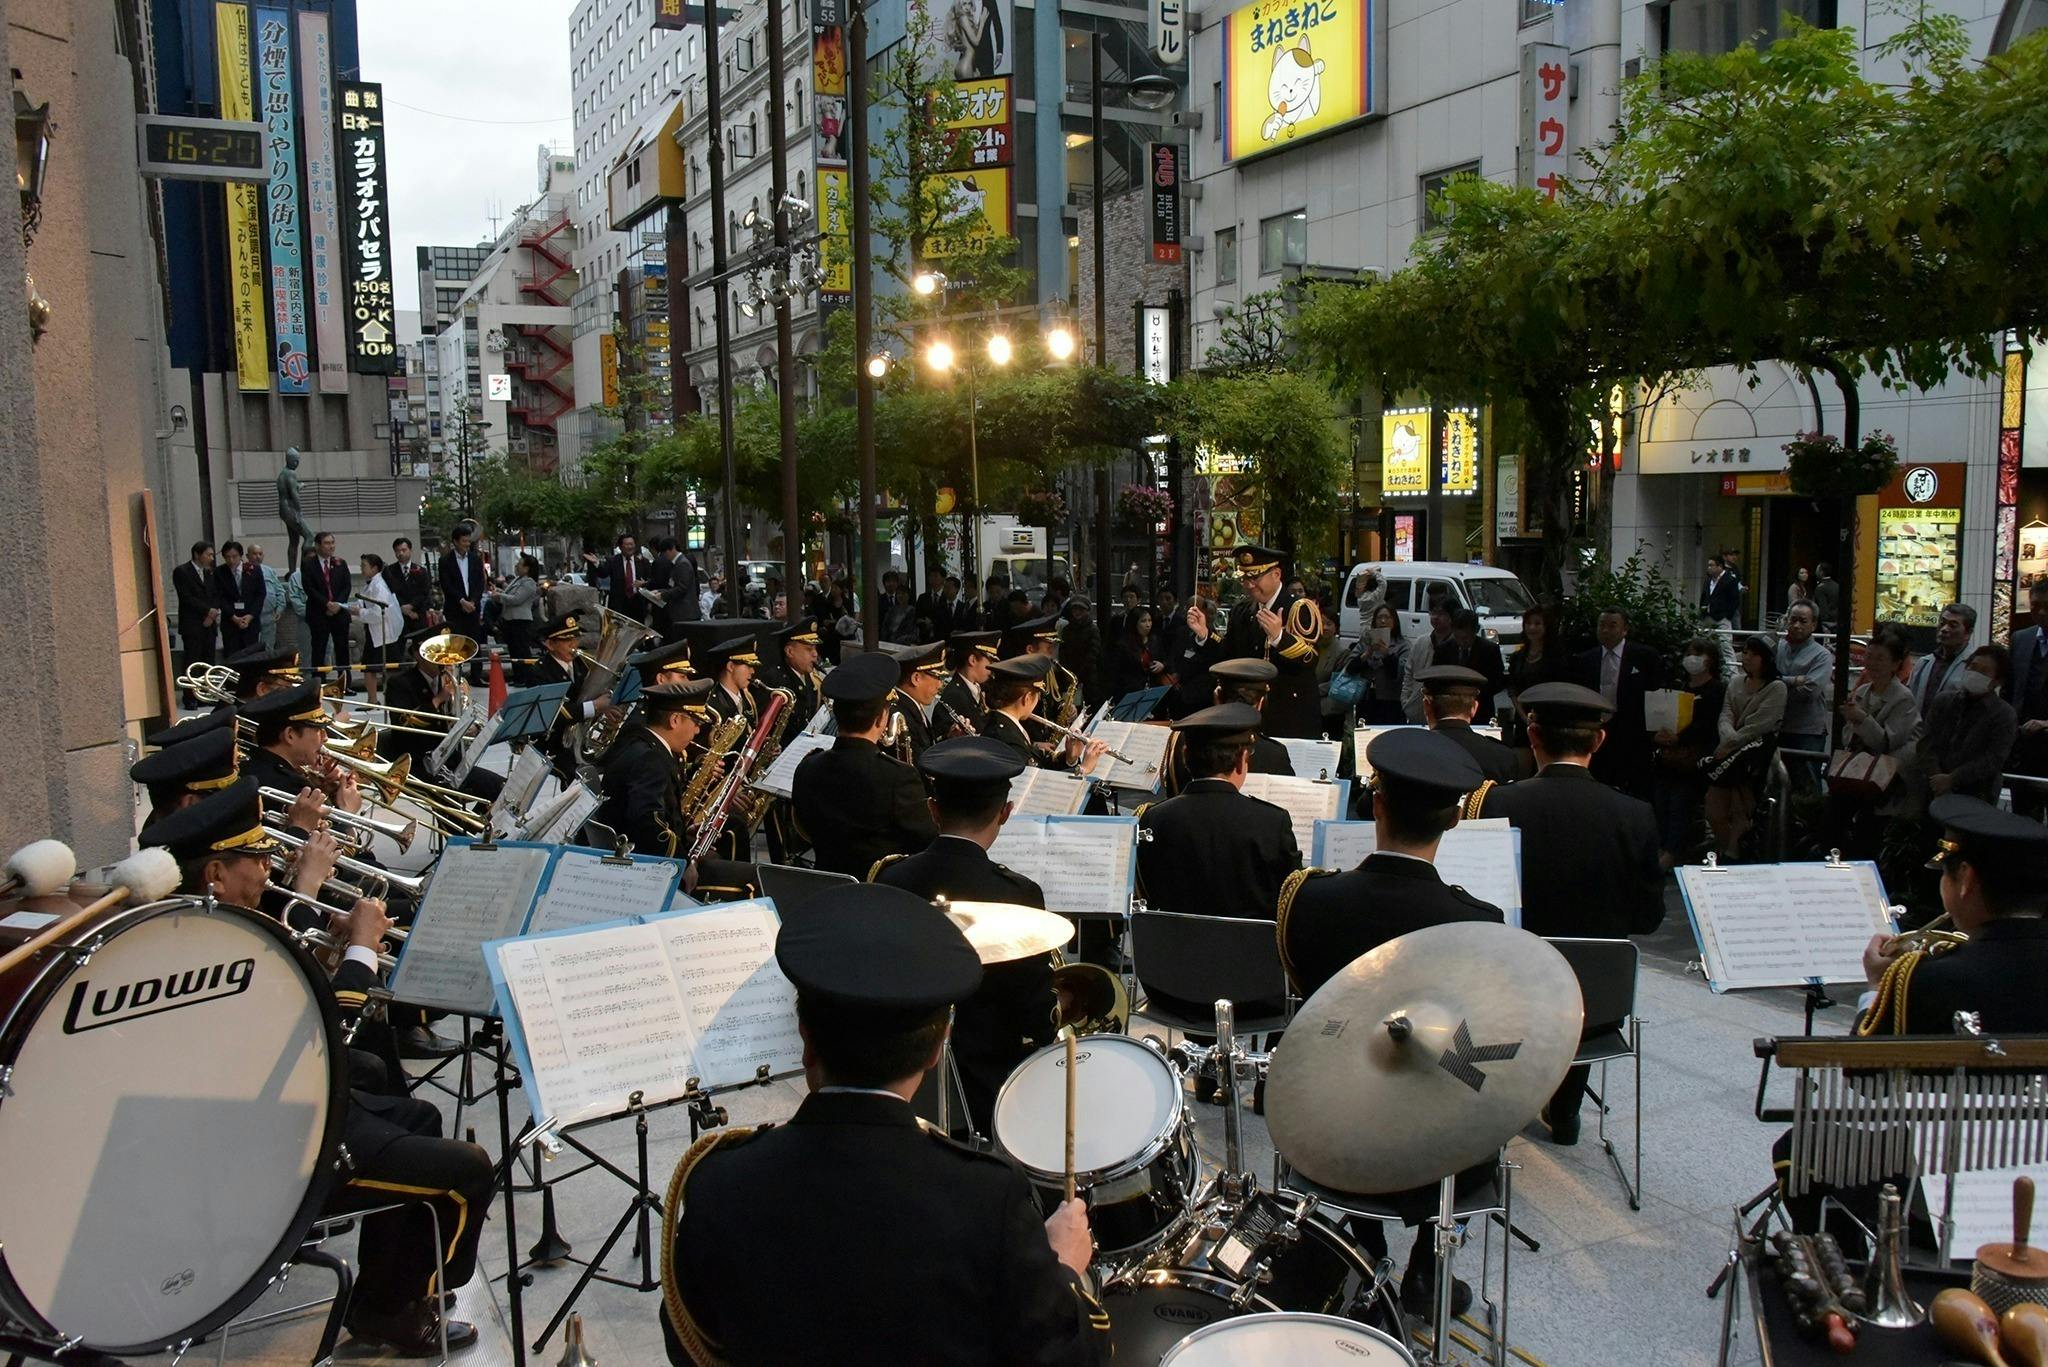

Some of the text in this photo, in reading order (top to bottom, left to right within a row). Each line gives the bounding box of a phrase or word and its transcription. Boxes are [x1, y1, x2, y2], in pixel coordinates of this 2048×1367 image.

[1161, 1, 1179, 53] ビル
[1250, 0, 1337, 53] まねきねこ
[342, 112, 383, 131] 日本一
[262, 20, 299, 256] 分煙で思いやりの街に。
[311, 160, 323, 213] まずは
[353, 137, 382, 282] カラオケパセラ
[1157, 194, 1174, 241] BRITISH PUB
[353, 280, 391, 294] 150名
[356, 343, 393, 356] 10秒
[1452, 420, 1461, 484] まねきねこ
[1691, 448, 1751, 464] レオ新宿
[1387, 474, 1422, 486] まねきねこ
[1724, 480, 1735, 490] B1
[1882, 510, 1956, 519] 24時間営業 年中無休
[1159, 1306, 1204, 1321] EVANS
